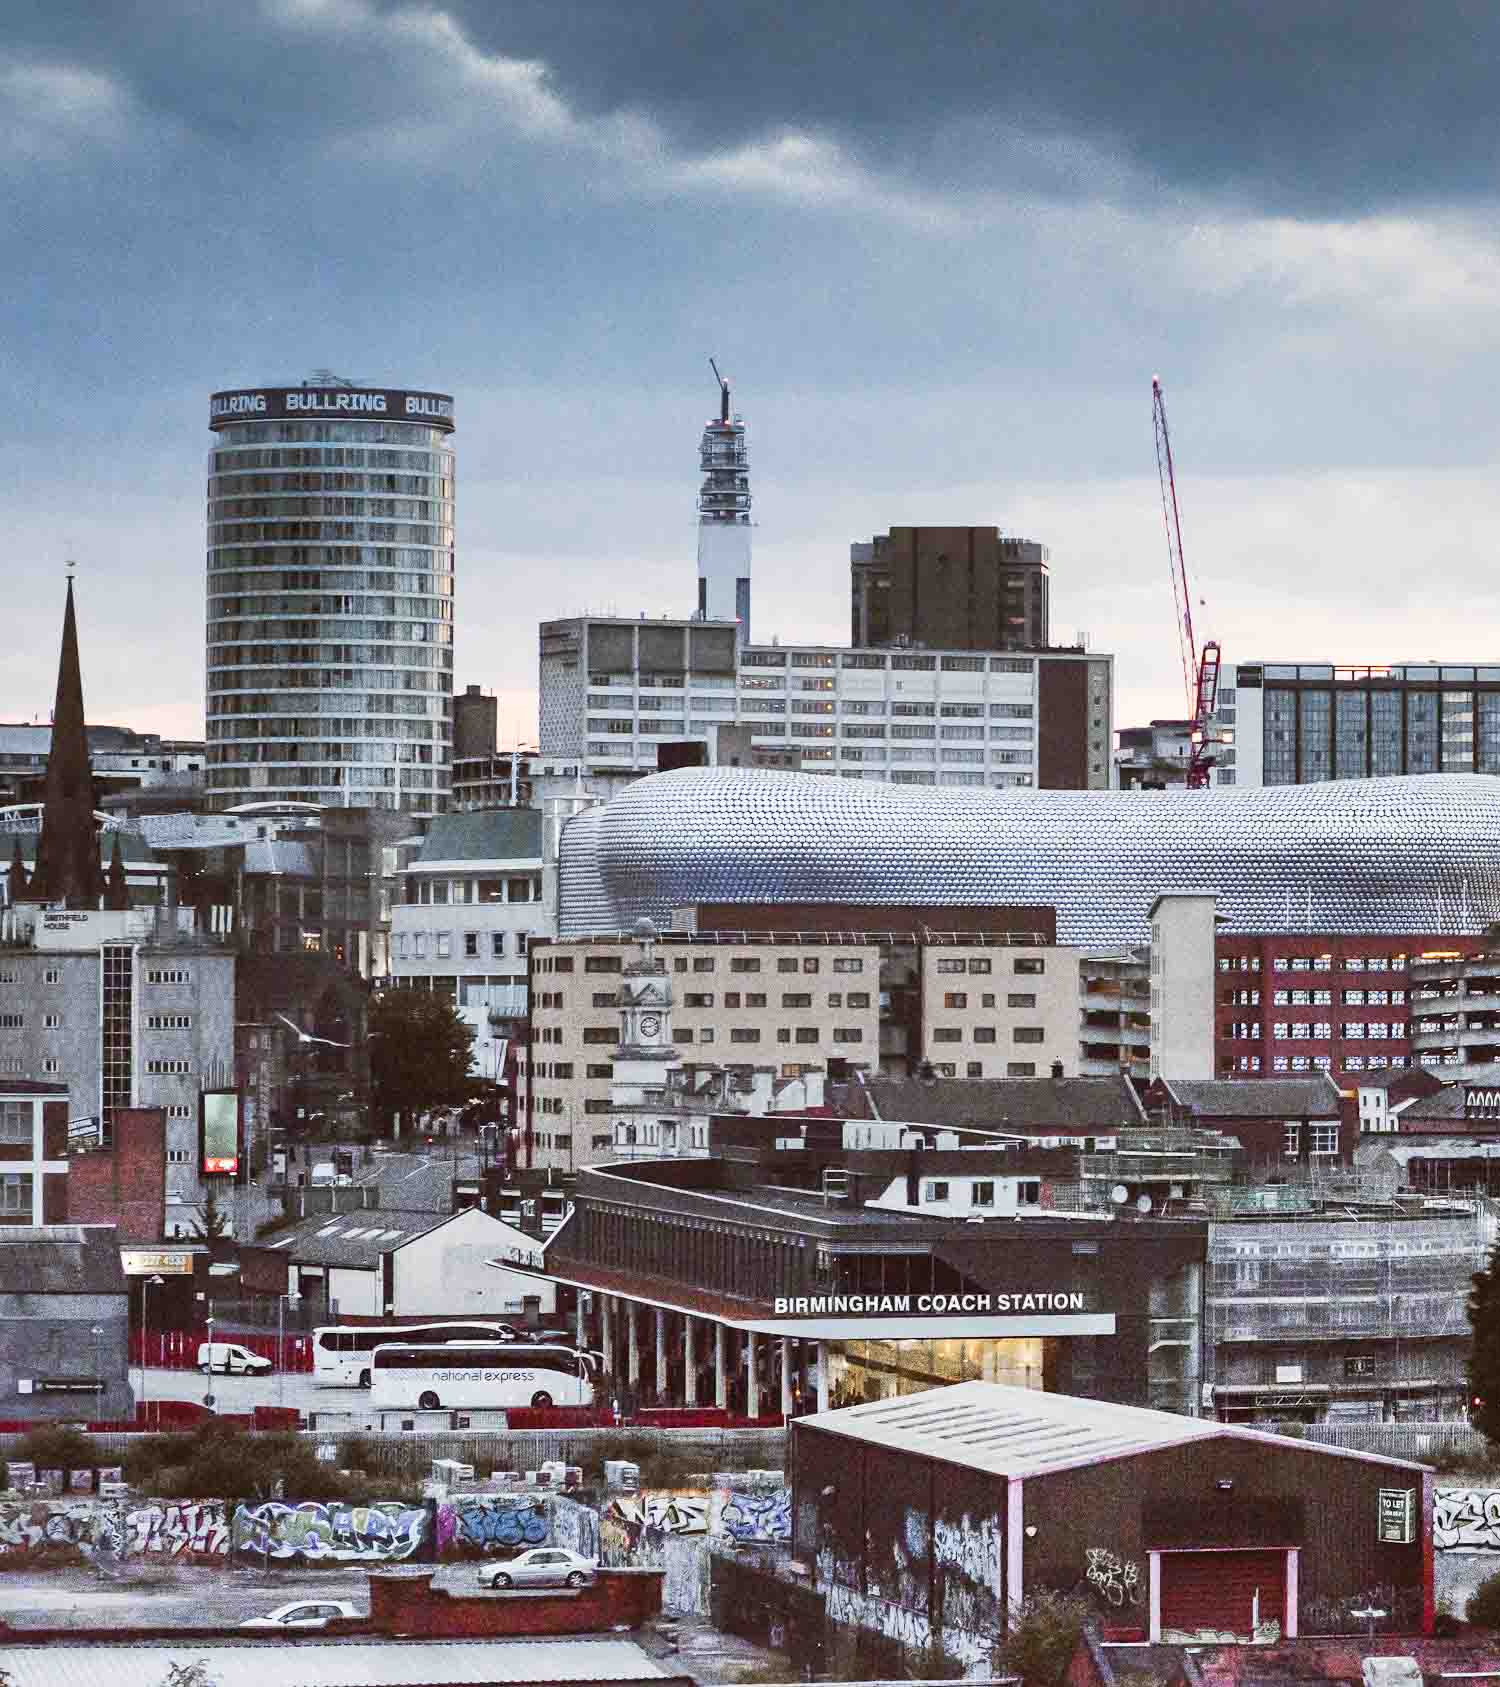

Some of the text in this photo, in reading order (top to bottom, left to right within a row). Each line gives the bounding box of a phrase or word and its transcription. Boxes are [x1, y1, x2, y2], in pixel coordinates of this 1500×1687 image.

[286, 393, 386, 411] BULLRING
[44, 922, 70, 930] HOUSE
[774, 1293, 1084, 1314] BIRMINGHAM COACH STATION
[432, 1369, 535, 1384] national express
[1383, 1499, 1404, 1509] TO LET
